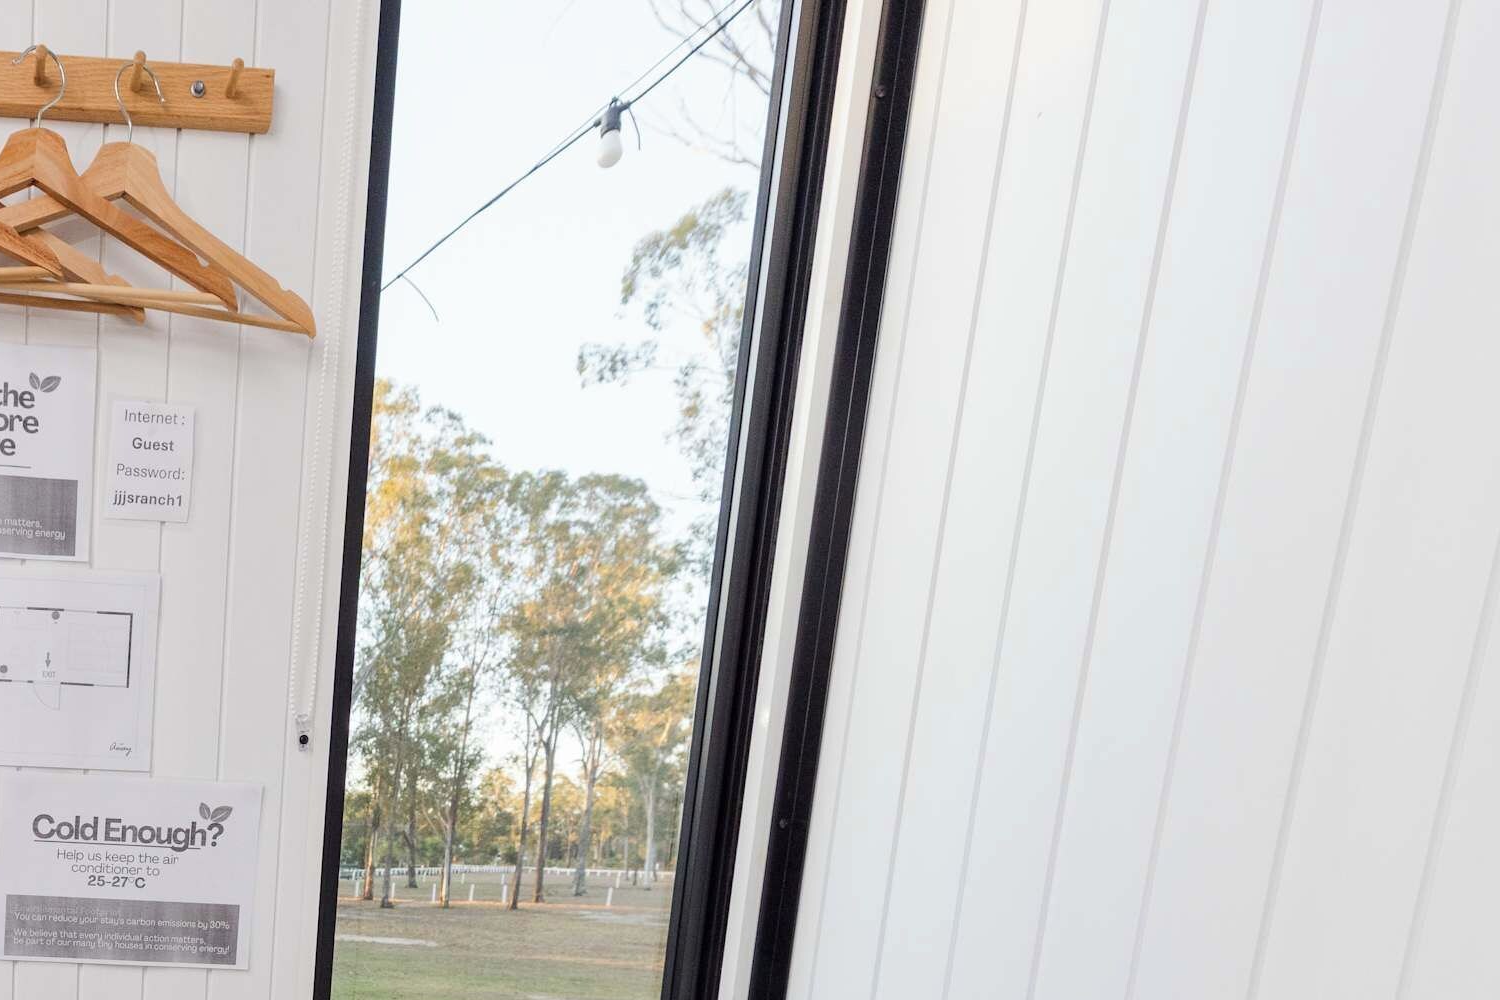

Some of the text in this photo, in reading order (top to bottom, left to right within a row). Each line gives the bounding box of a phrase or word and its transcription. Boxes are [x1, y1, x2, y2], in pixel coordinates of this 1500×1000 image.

[124, 409, 178, 425] Internet
[132, 437, 175, 451] Guest
[116, 463, 185, 480] Password:
[113, 490, 182, 507] jjjsranch1
[32, 813, 224, 852] Cold Enough?
[57, 848, 179, 865] Help us keep the air
[71, 863, 160, 877] conditioner to
[126, 919, 156, 927] carbon
[157, 920, 197, 929] emissions
[104, 932, 142, 941] individual
[143, 934, 170, 943] action
[114, 941, 143, 950] houses
[154, 943, 198, 954] conserving
